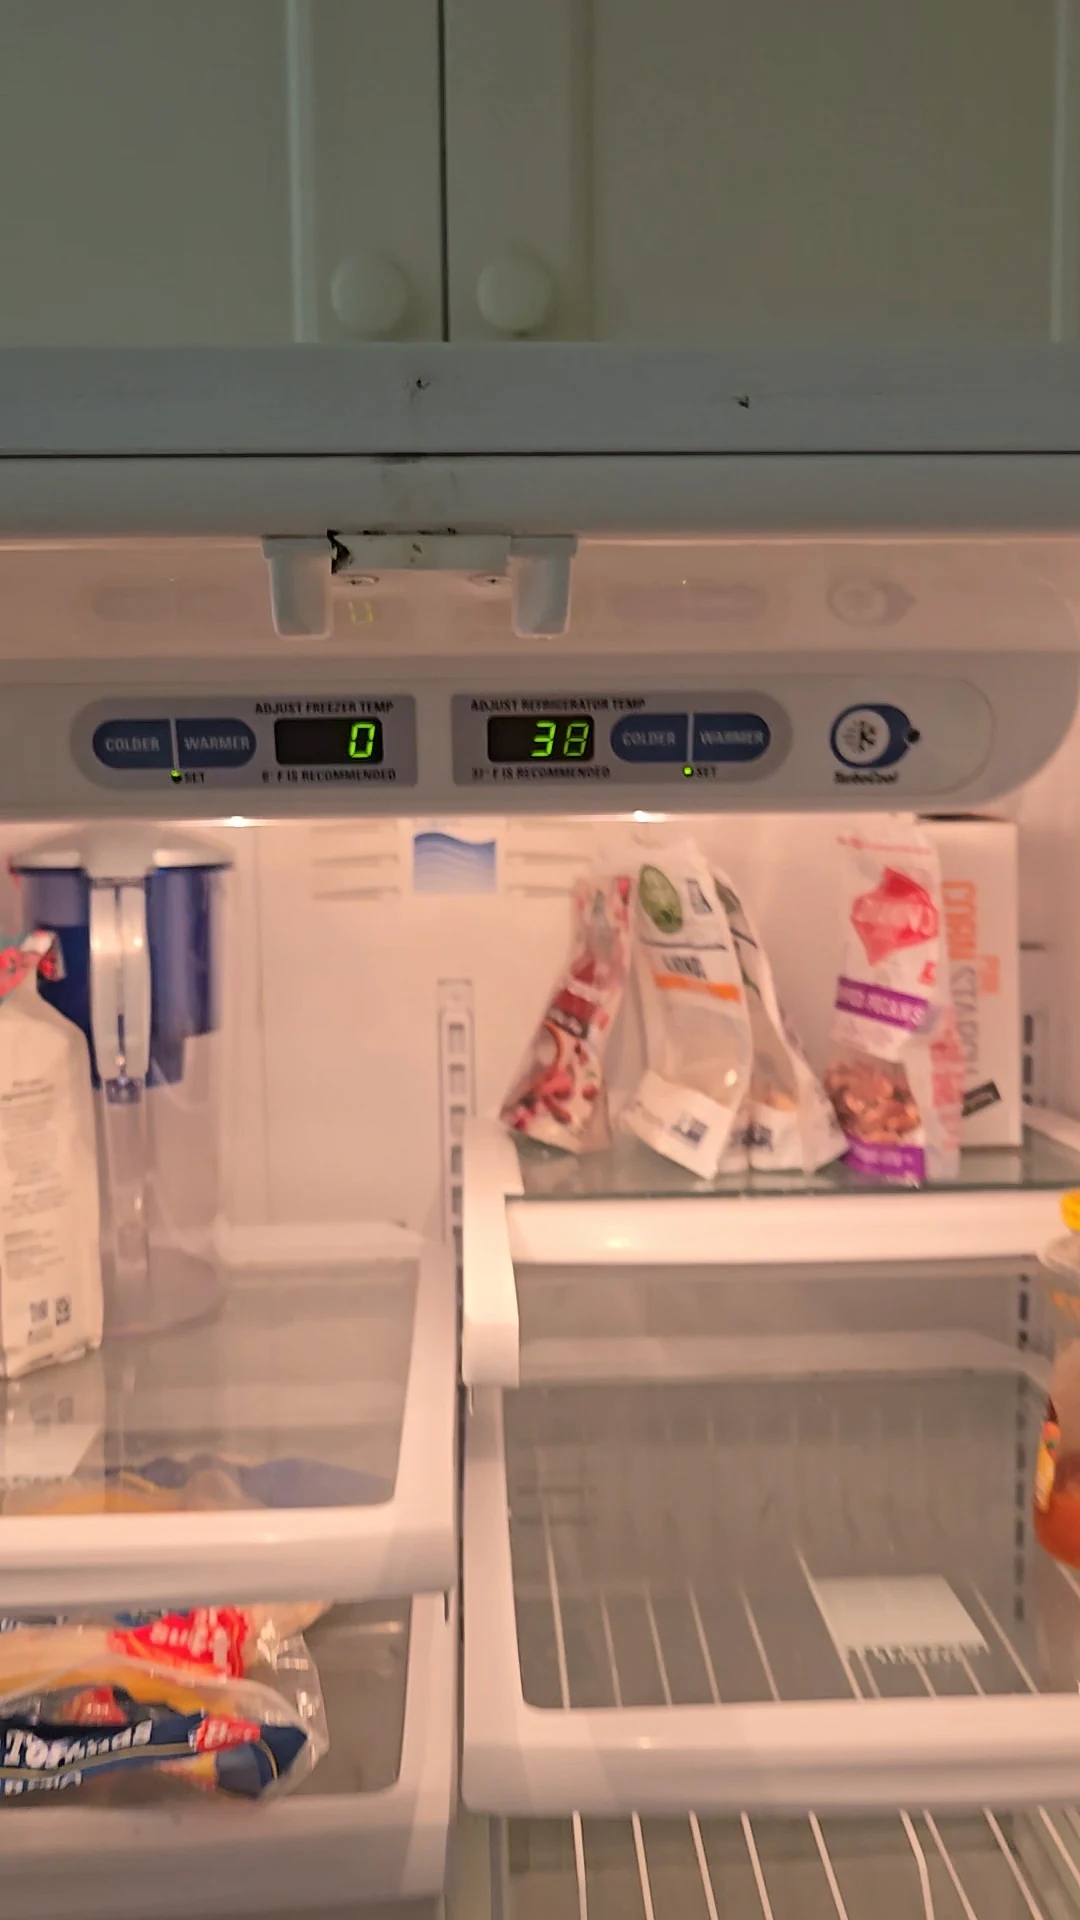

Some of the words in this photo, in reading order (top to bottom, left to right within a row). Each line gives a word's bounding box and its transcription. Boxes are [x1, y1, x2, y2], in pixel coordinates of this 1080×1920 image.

[254, 700, 302, 715] ADJUST
[305, 700, 357, 714] FREEZER
[360, 699, 395, 713] TEMP
[470, 698, 518, 712] ADJUST
[612, 697, 646, 711] TEMP
[104, 737, 160, 753] COLDER
[183, 735, 250, 751] WARMER
[349, 721, 376, 759] 0
[530, 720, 590, 758] 38
[621, 730, 677, 746] COLDER
[699, 730, 765, 745] WARMER
[184, 771, 206, 784] SET
[301, 769, 397, 783] RECOMMENDED
[516, 767, 611, 779] RECOMMENDED
[695, 766, 717, 778] SET
